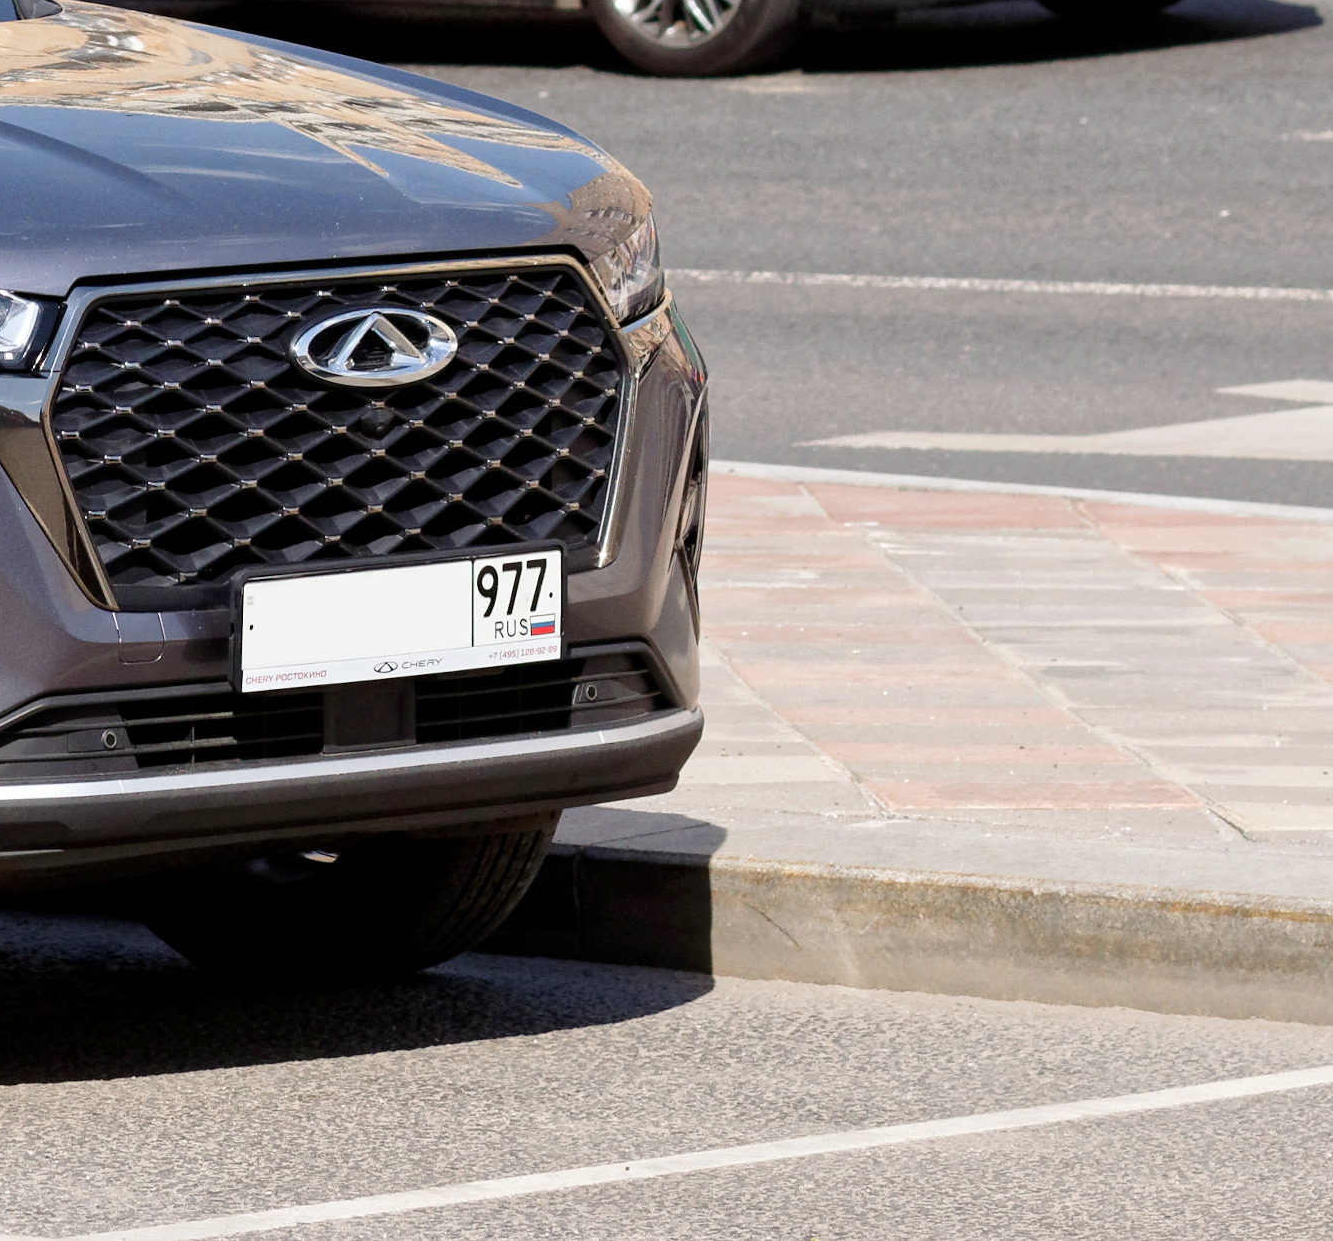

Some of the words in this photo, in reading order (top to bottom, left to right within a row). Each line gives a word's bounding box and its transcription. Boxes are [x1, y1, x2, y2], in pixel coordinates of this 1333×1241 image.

[476, 559, 548, 618] 977
[494, 618, 529, 640] RUS
[401, 658, 444, 669] CHERY
[245, 674, 274, 685] CHERY
[276, 670, 327, 682] РОСТОКИНО
